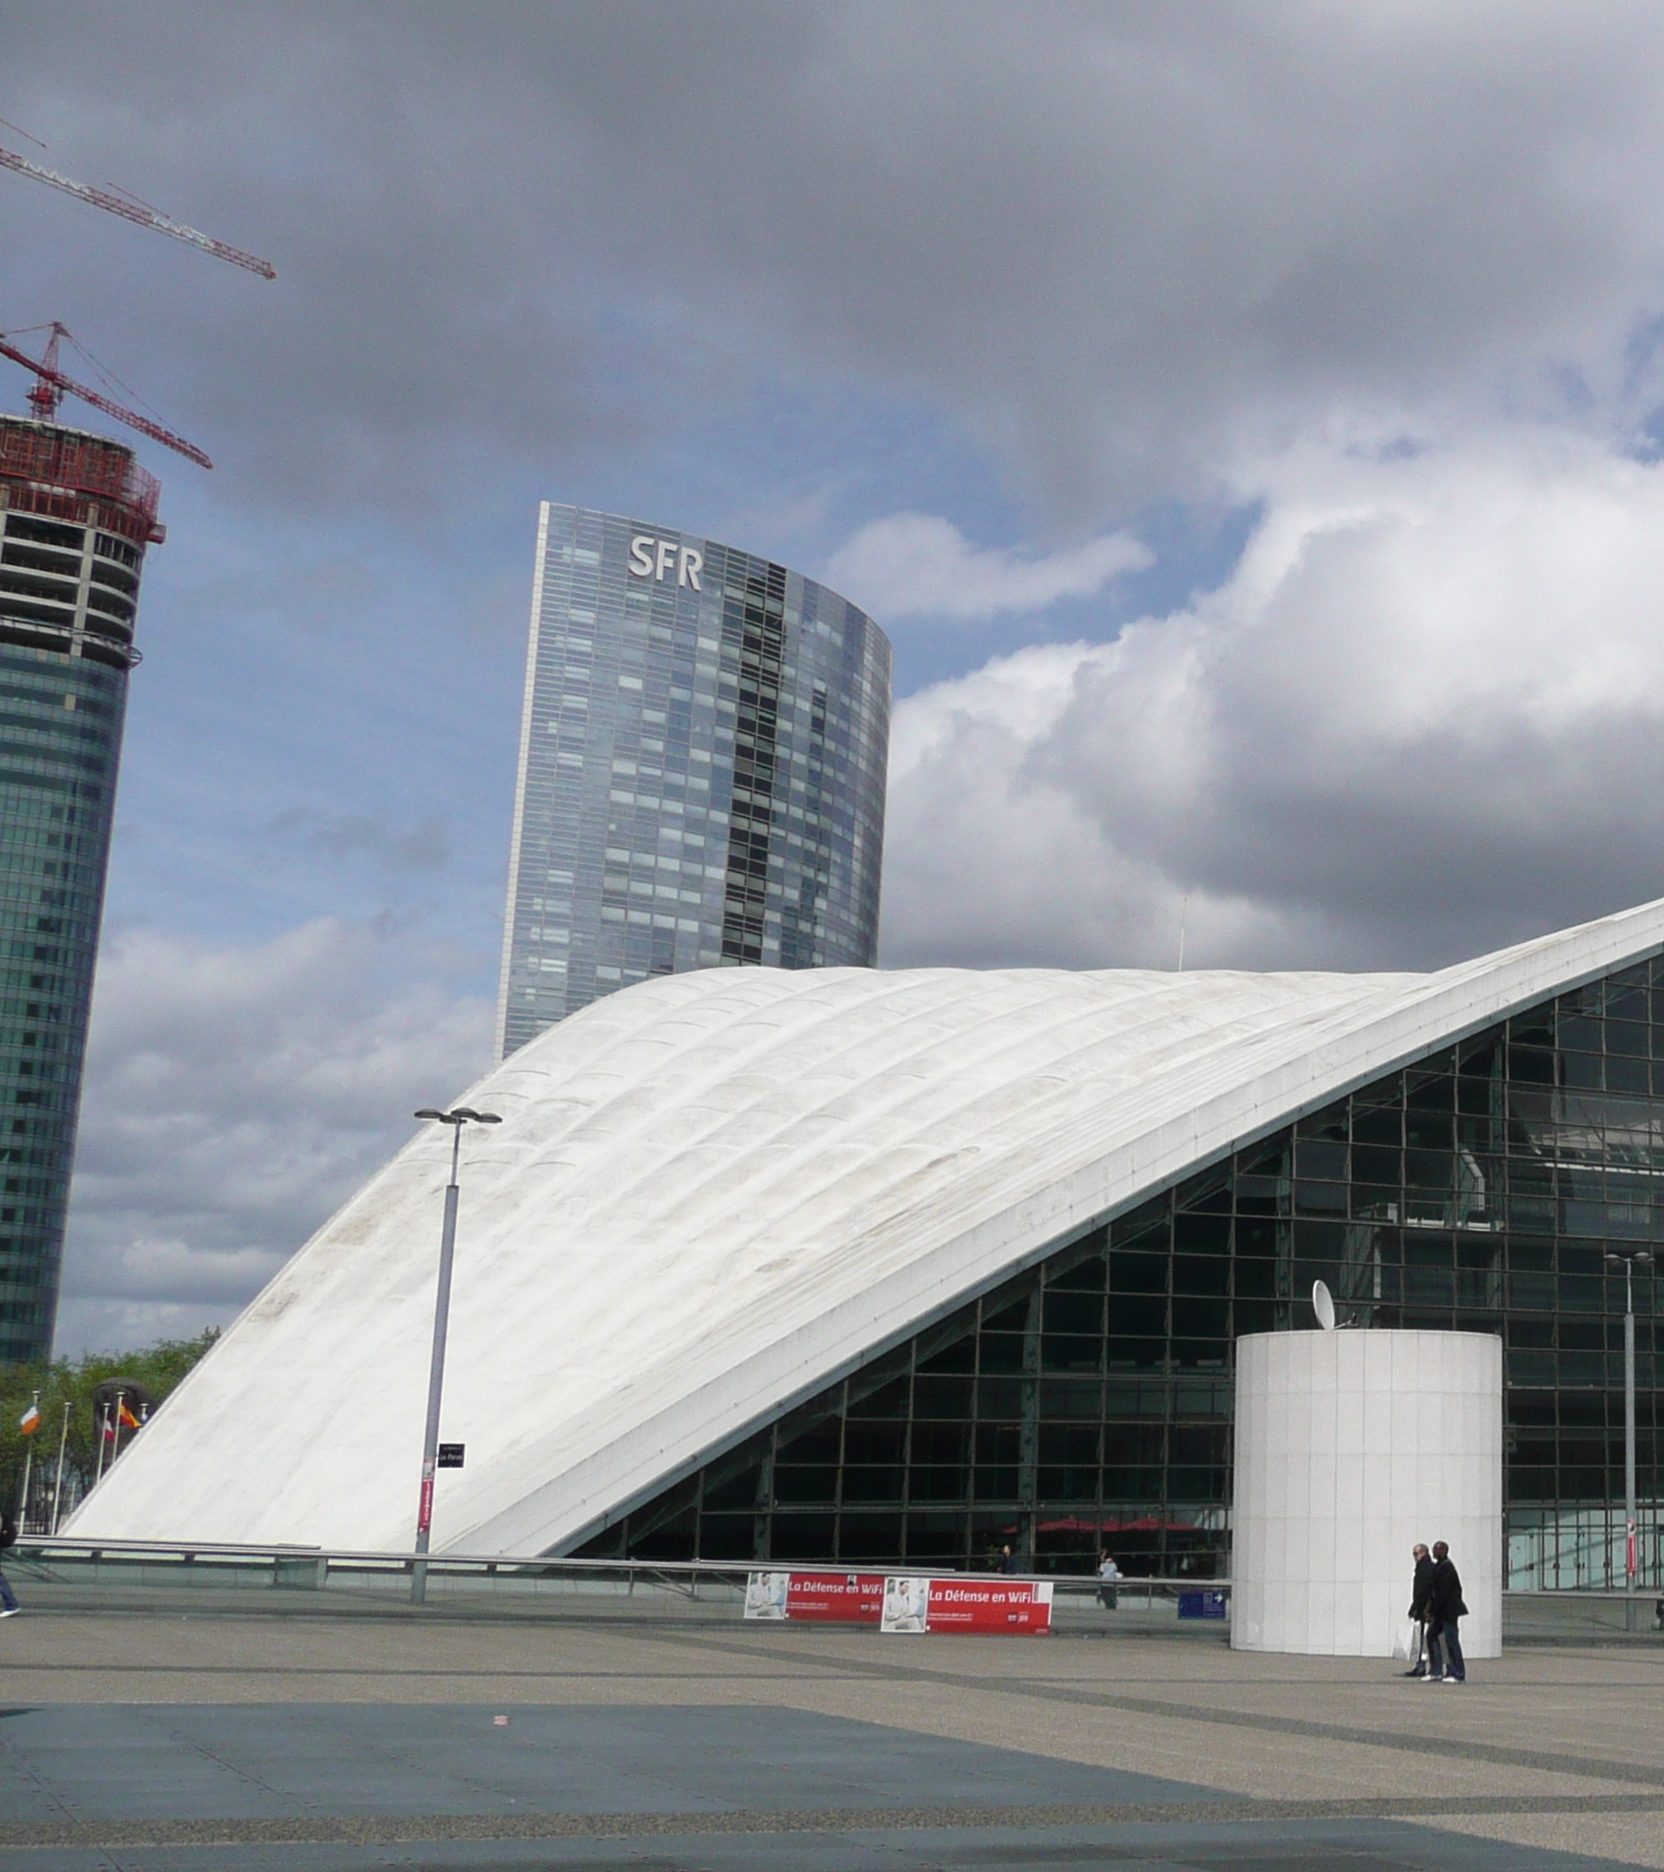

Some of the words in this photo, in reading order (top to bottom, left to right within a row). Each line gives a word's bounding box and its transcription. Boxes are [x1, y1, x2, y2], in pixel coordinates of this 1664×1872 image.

[628, 535, 703, 592] SFR
[788, 1581, 801, 1592] La
[803, 1582, 844, 1593] Défense
[847, 1585, 859, 1594] en
[861, 1584, 883, 1595] WiFi
[929, 1590, 942, 1601] La
[945, 1590, 990, 1603] Défense
[992, 1593, 1005, 1602] en
[1008, 1592, 1031, 1604] WiFi
